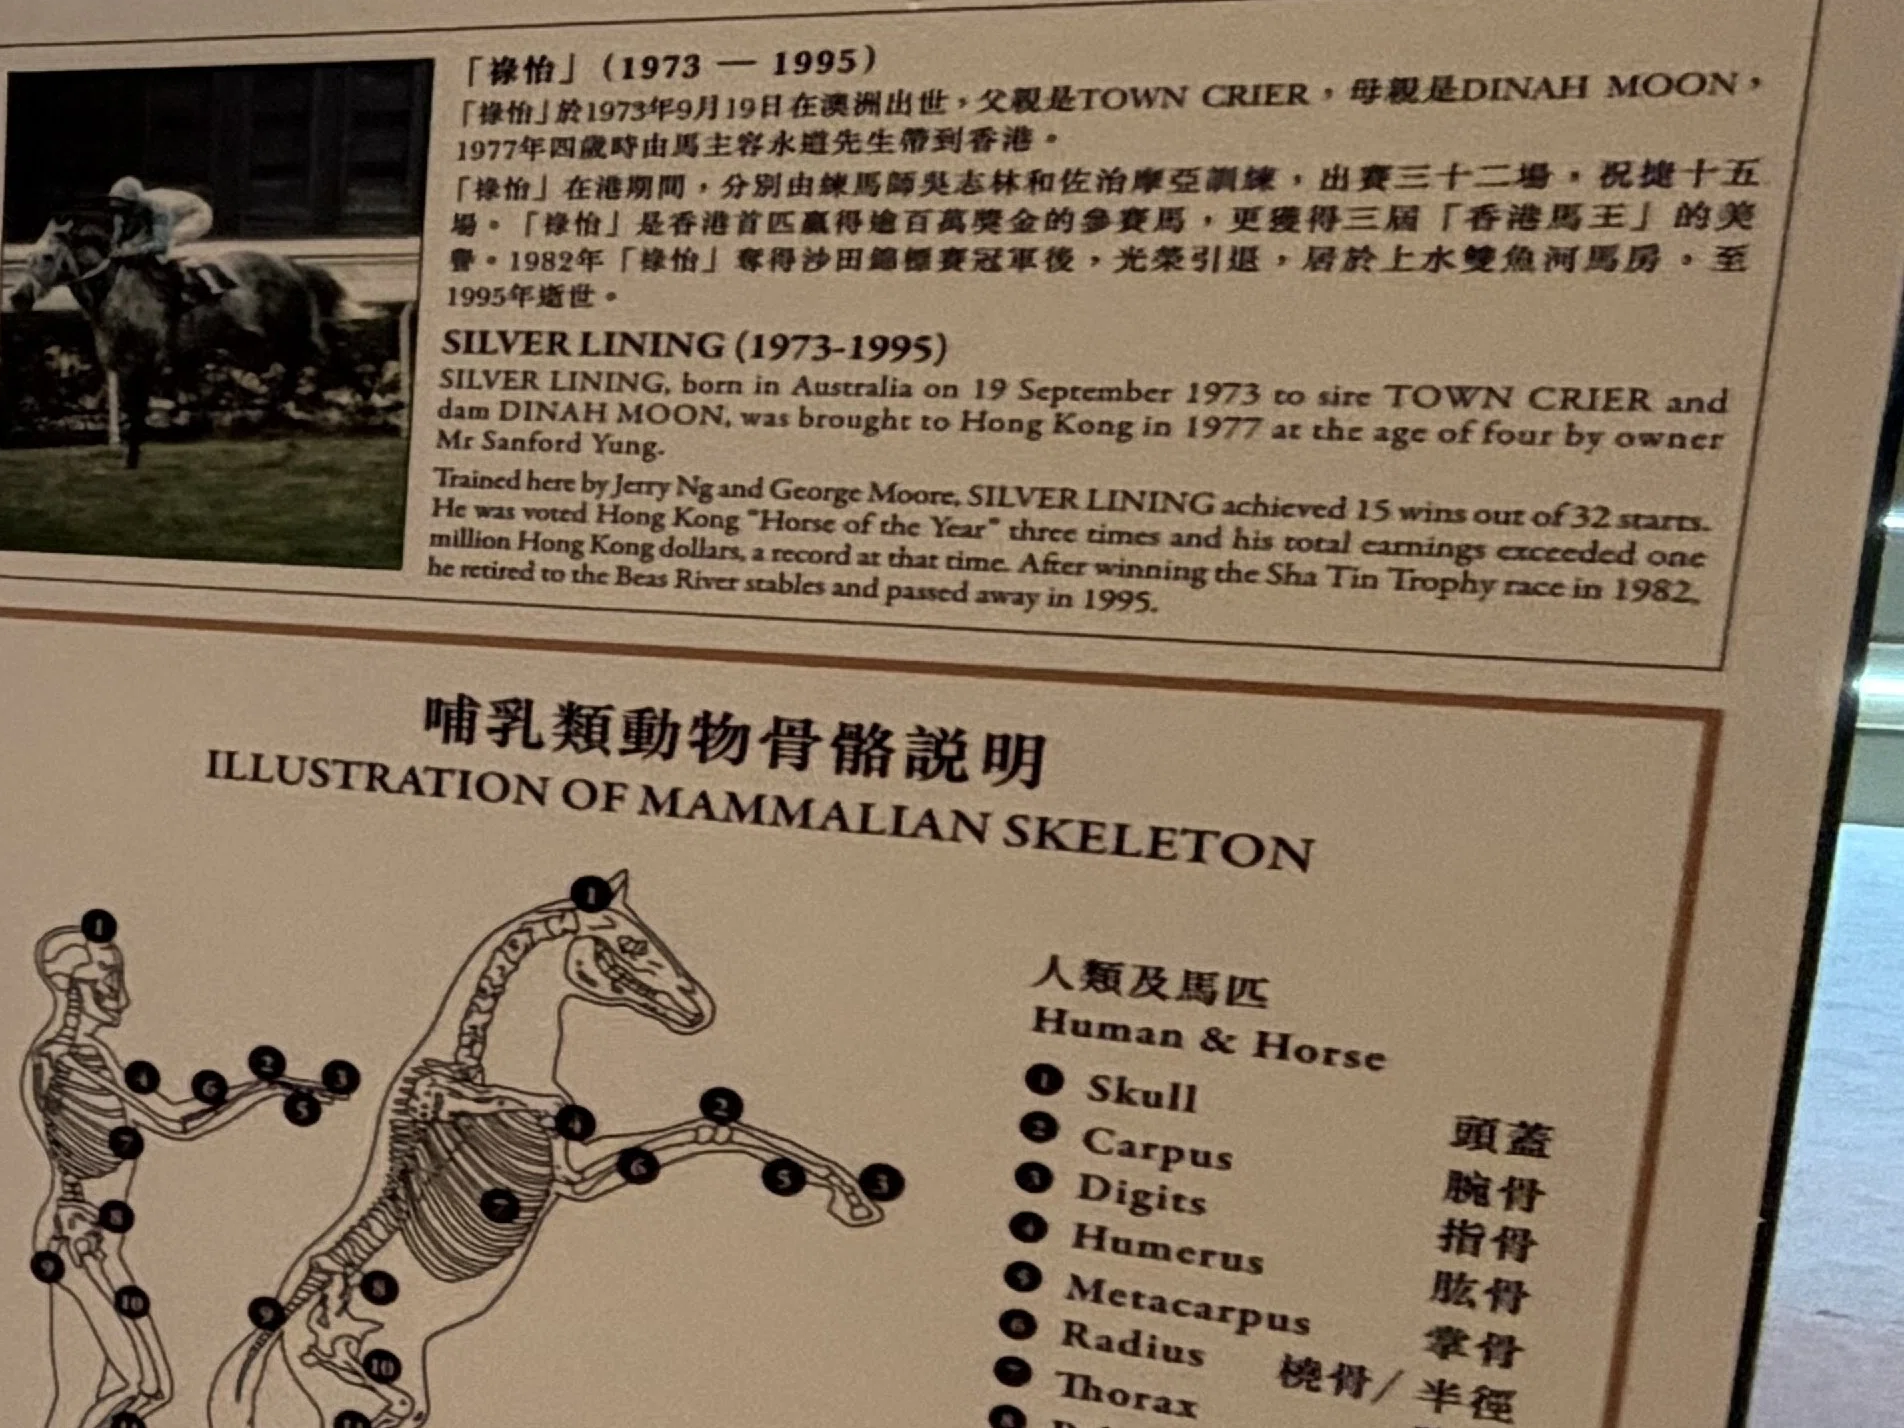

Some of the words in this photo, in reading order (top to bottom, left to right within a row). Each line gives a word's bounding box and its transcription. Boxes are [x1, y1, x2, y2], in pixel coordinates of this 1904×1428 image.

[440, 327, 573, 358] SILVER
[576, 329, 727, 361] LINING
[733, 328, 950, 368] (1973-1995)
[437, 367, 541, 392] SILVER
[548, 369, 673, 397] LINING,
[681, 370, 744, 397] born
[752, 374, 782, 397] in
[789, 373, 914, 400] Australia
[922, 382, 961, 400] on
[974, 376, 1010, 402] 19
[1016, 376, 1175, 410] September
[1185, 380, 1263, 407] 1973
[1272, 387, 1307, 407] to
[1316, 383, 1373, 409] sire
[1382, 383, 1516, 411] TOWN
[1526, 385, 1654, 414] CRIER
[1664, 385, 1731, 416] and
[435, 427, 475, 451] Mr
[480, 428, 583, 455] Sanford
[590, 431, 666, 465] Yung.
[436, 395, 491, 422] dam
[497, 398, 609, 425] DINAH
[615, 401, 733, 430] MOON,
[739, 411, 791, 429] was
[796, 403, 913, 439] brought
[919, 413, 953, 434] to
[958, 407, 1046, 443] Hong
[1051, 410, 1136, 446] Kong
[1141, 414, 1173, 439] in
[1185, 414, 1265, 441] 1977
[1269, 422, 1304, 442] at
[1311, 415, 1365, 443] the
[1372, 425, 1430, 452] age
[1436, 417, 1479, 446] of
[1481, 417, 1556, 448] four
[1563, 420, 1606, 457] by
[1613, 430, 1726, 452] owner
[431, 465, 523, 492] Trained
[525, 467, 577, 494] here
[579, 468, 611, 501] by
[608, 471, 673, 504] Jerry
[675, 473, 716, 506] Ng
[716, 474, 765, 501] and
[768, 476, 864, 511] George
[865, 480, 964, 510] Moore,
[965, 483, 1082, 512] SILVER
[1083, 486, 1217, 517] LINING
[1219, 491, 1349, 522] achieved
[1355, 497, 1393, 524] 15
[1397, 499, 1469, 525] wins
[1471, 507, 1527, 528] out
[1529, 500, 1572, 529] of
[1568, 511, 1614, 529] 32
[1614, 512, 1713, 534] starts.
[430, 495, 468, 520] He
[472, 504, 517, 521] was
[521, 499, 589, 525] voted
[595, 501, 667, 535] Hong
[671, 505, 742, 538] Kong
[841, 509, 878, 536] of
[878, 511, 922, 539] the
[1007, 517, 1079, 545] three
[1085, 522, 1162, 548] times
[1168, 522, 1224, 551] and
[1230, 524, 1275, 553] his
[1282, 528, 1353, 556] total
[1359, 535, 1488, 569] earnings
[1495, 538, 1639, 568] exceeded
[1645, 548, 1708, 570] one
[426, 554, 456, 578] he
[459, 558, 537, 582] retired
[539, 566, 567, 583] to
[570, 560, 611, 585] the
[614, 563, 668, 588] Beas
[673, 566, 741, 592] River
[742, 570, 827, 597] stables
[830, 574, 881, 599] and
[884, 578, 970, 608] passed
[974, 588, 1042, 614] away
[1045, 586, 1075, 609] in
[1083, 587, 1159, 615] 1995.
[428, 525, 513, 552] million
[515, 529, 586, 562] Hong
[588, 532, 656, 565] Kong
[657, 533, 748, 564] dollars,
[750, 546, 767, 563] a
[770, 541, 853, 567] record
[855, 550, 883, 569] at
[886, 543, 940, 571] that
[1015, 549, 1091, 578] After
[1092, 556, 1211, 591] winning
[1212, 557, 1261, 586] the
[1263, 560, 1319, 589] Sha
[1324, 562, 1380, 591] Tin
[1385, 565, 1500, 604] Trophy
[1501, 578, 1567, 599] race
[1570, 576, 1605, 602] in
[204, 747, 553, 808] ILLUSTRATION
[560, 776, 631, 814] OF
[636, 783, 995, 846] MAMMALIAN
[1001, 812, 1318, 875] SKELETON
[1029, 953, 1271, 1011] 人類及馬匹
[1029, 1004, 1185, 1051] Human
[1197, 1025, 1239, 1057] &
[1250, 1029, 1388, 1074] Horse
[1085, 1073, 1199, 1115] Skull
[1080, 1125, 1234, 1175] Carpus
[1447, 1113, 1557, 1161] 頭蓋
[1075, 1171, 1208, 1219] Digits
[1441, 1167, 1549, 1215] 腕骨
[1070, 1221, 1265, 1277] Humerus
[1435, 1215, 1540, 1266] 指骨
[1063, 1271, 1312, 1338] Metacarpus
[1059, 1318, 1207, 1369] Radius
[1053, 1369, 1199, 1422] Thorax
